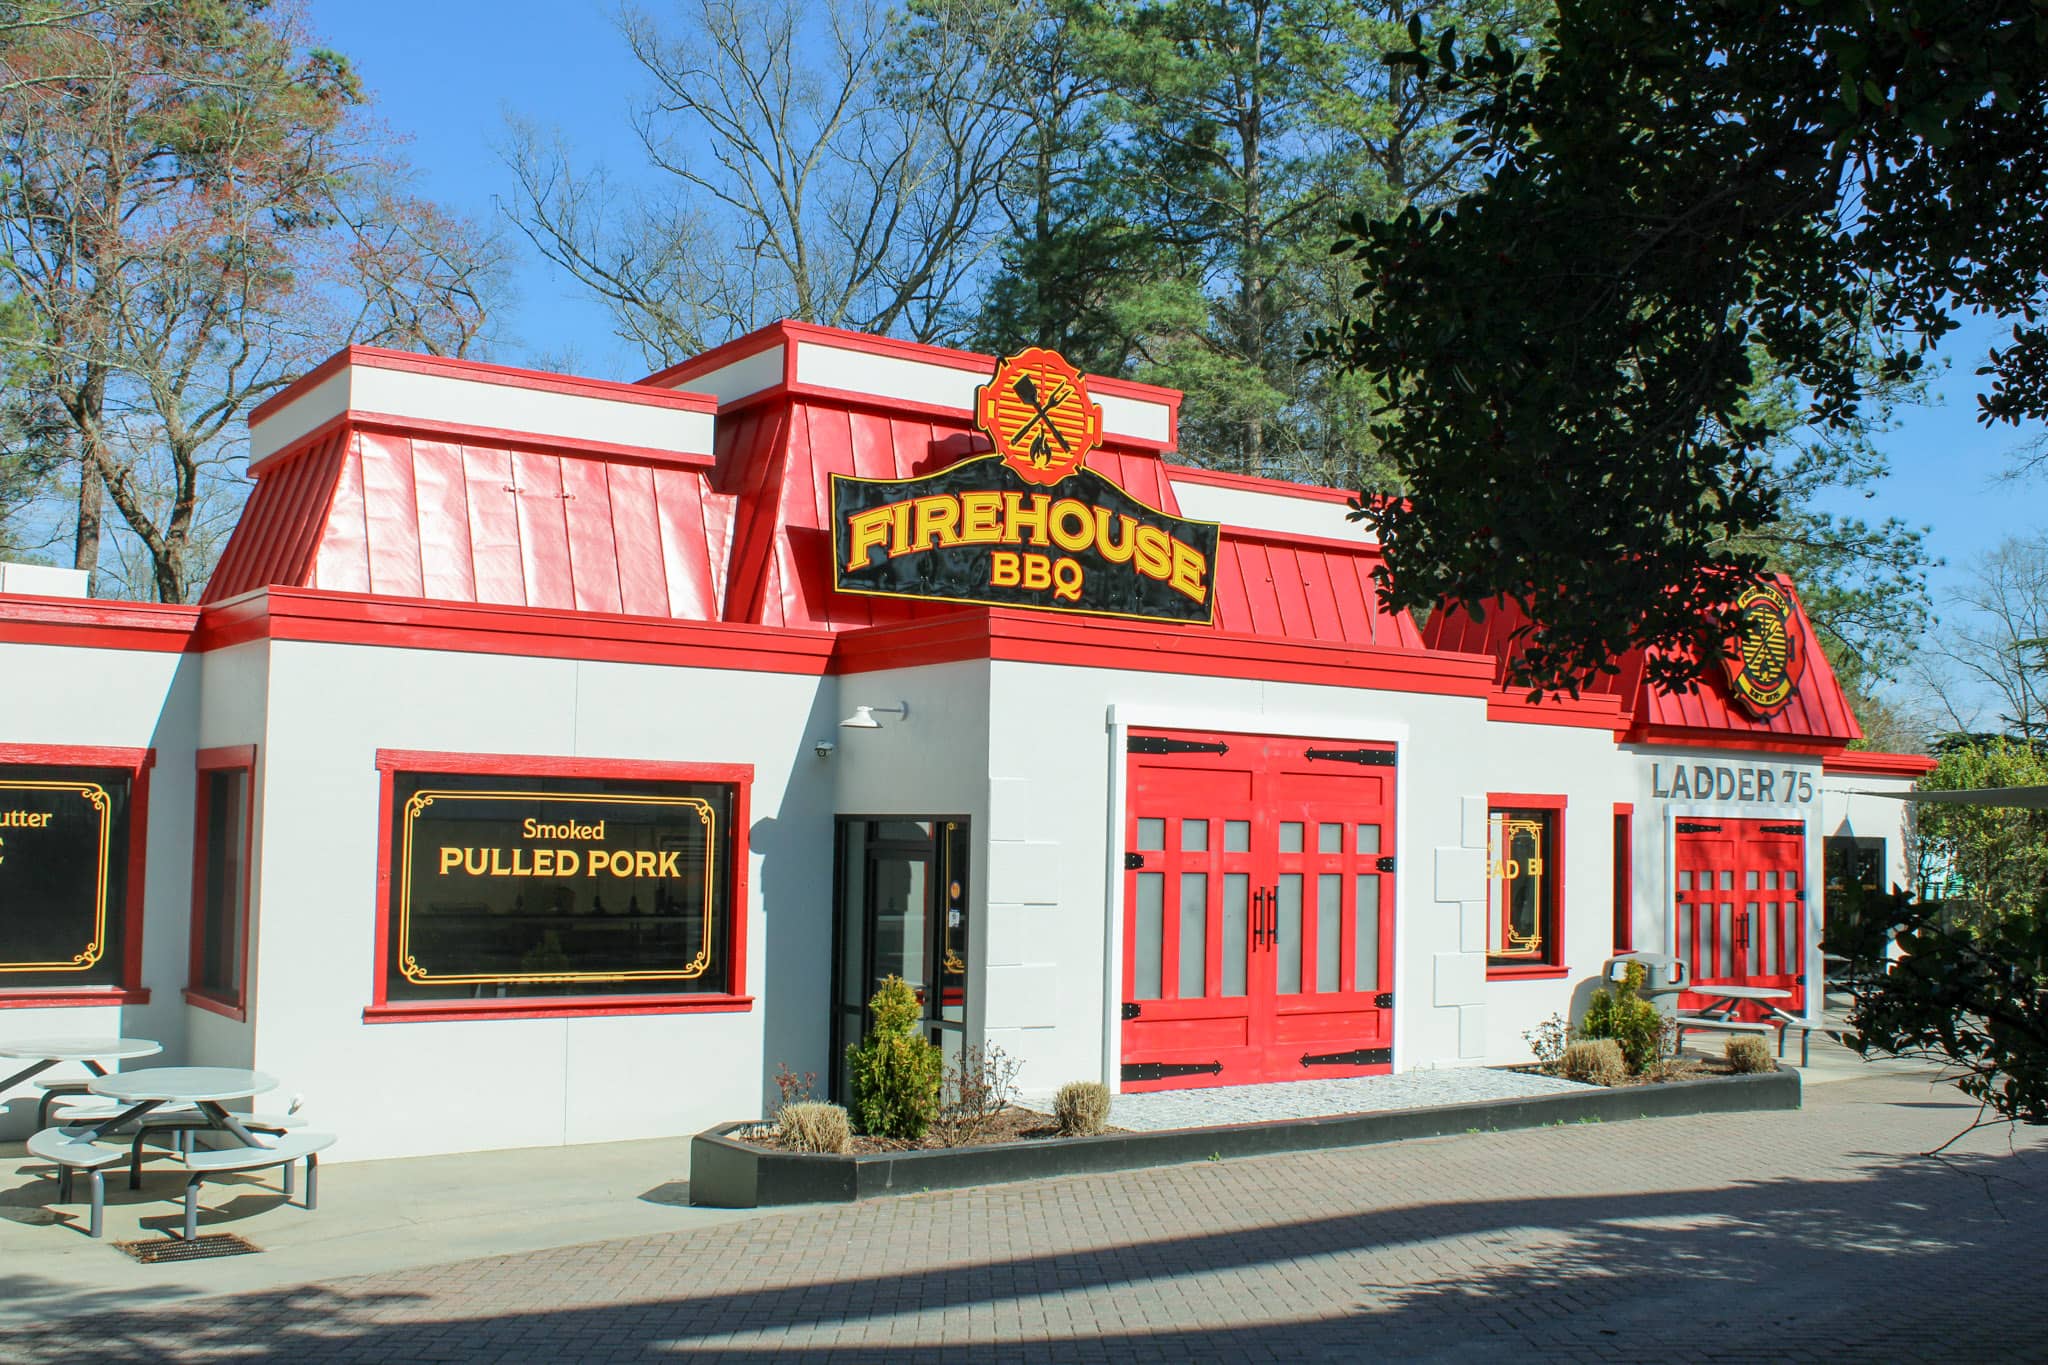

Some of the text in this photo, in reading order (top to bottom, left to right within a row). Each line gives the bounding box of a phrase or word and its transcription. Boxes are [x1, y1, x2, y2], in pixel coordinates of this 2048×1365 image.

[848, 491, 1208, 604] FIREHOUSE
[990, 551, 1084, 602] BBQ
[1651, 763, 1813, 803] LADDER 75
[523, 818, 605, 840] Smoked
[439, 847, 682, 878] PULLED PORK
